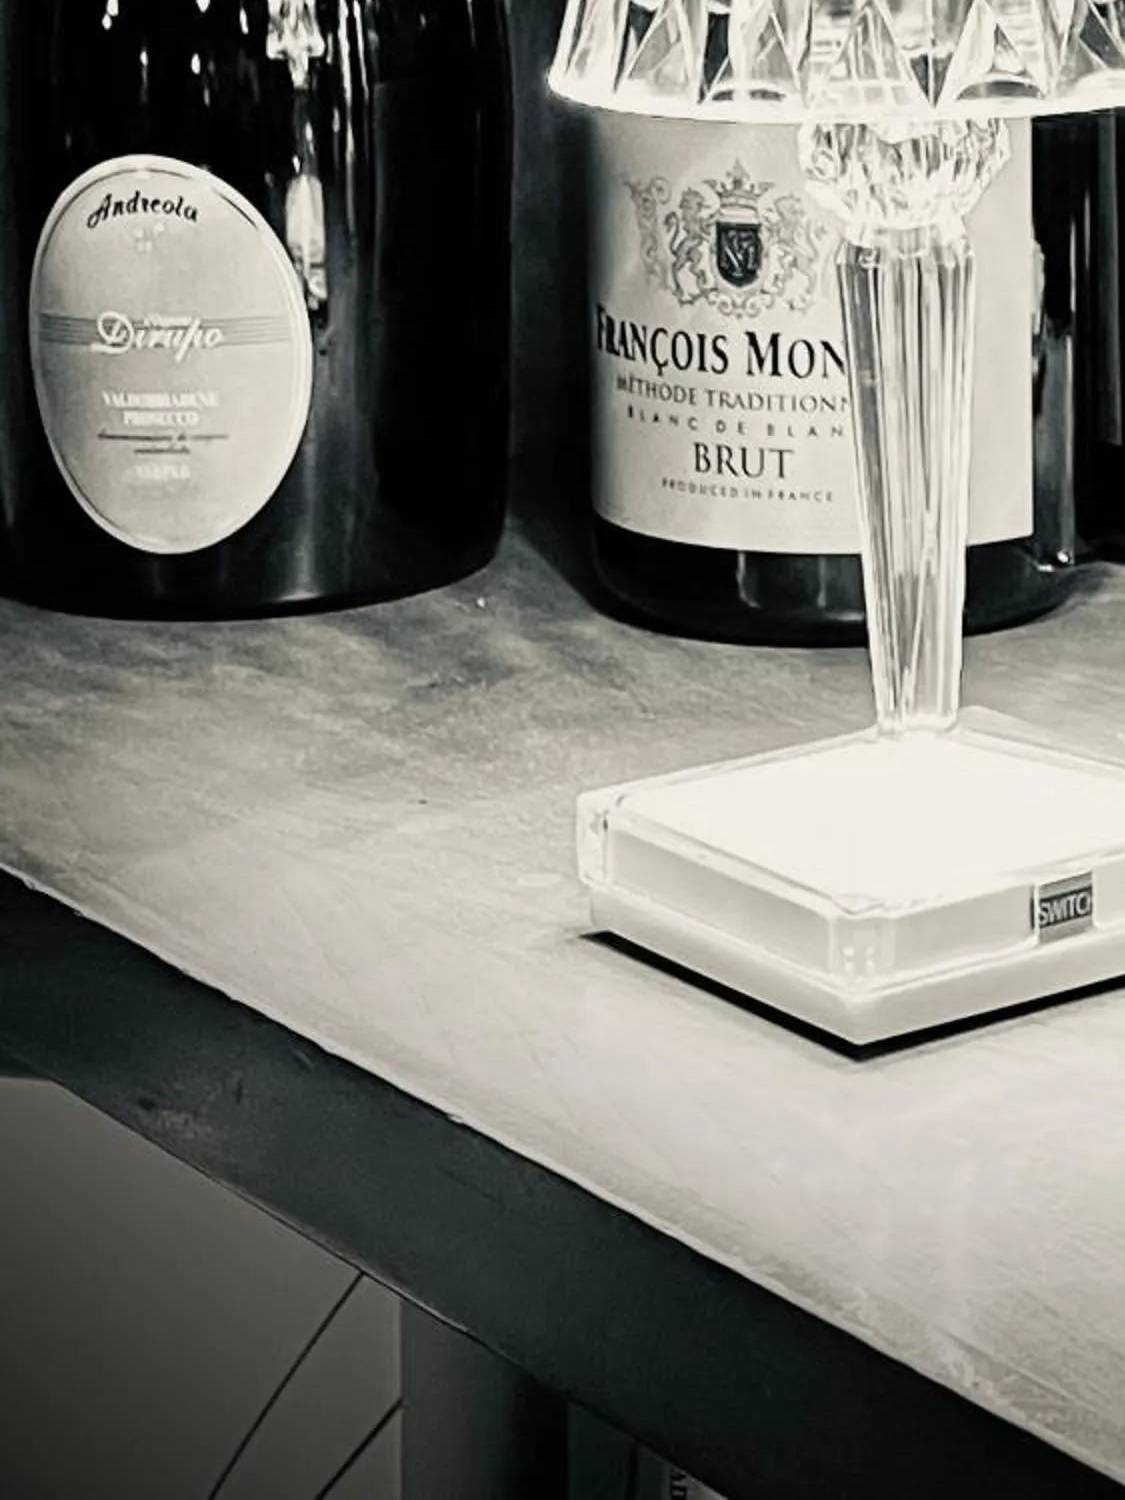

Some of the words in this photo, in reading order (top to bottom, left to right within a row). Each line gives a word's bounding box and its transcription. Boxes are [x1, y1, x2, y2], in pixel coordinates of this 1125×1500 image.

[86, 189, 198, 229] Andreola
[595, 303, 729, 376] FRANÇOIS
[627, 404, 699, 432] BLANC
[715, 419, 748, 435] DE
[693, 441, 795, 479] BRUT
[661, 476, 739, 498] PRODUCED
[744, 487, 762, 500] IN
[767, 488, 834, 503] FRANCE
